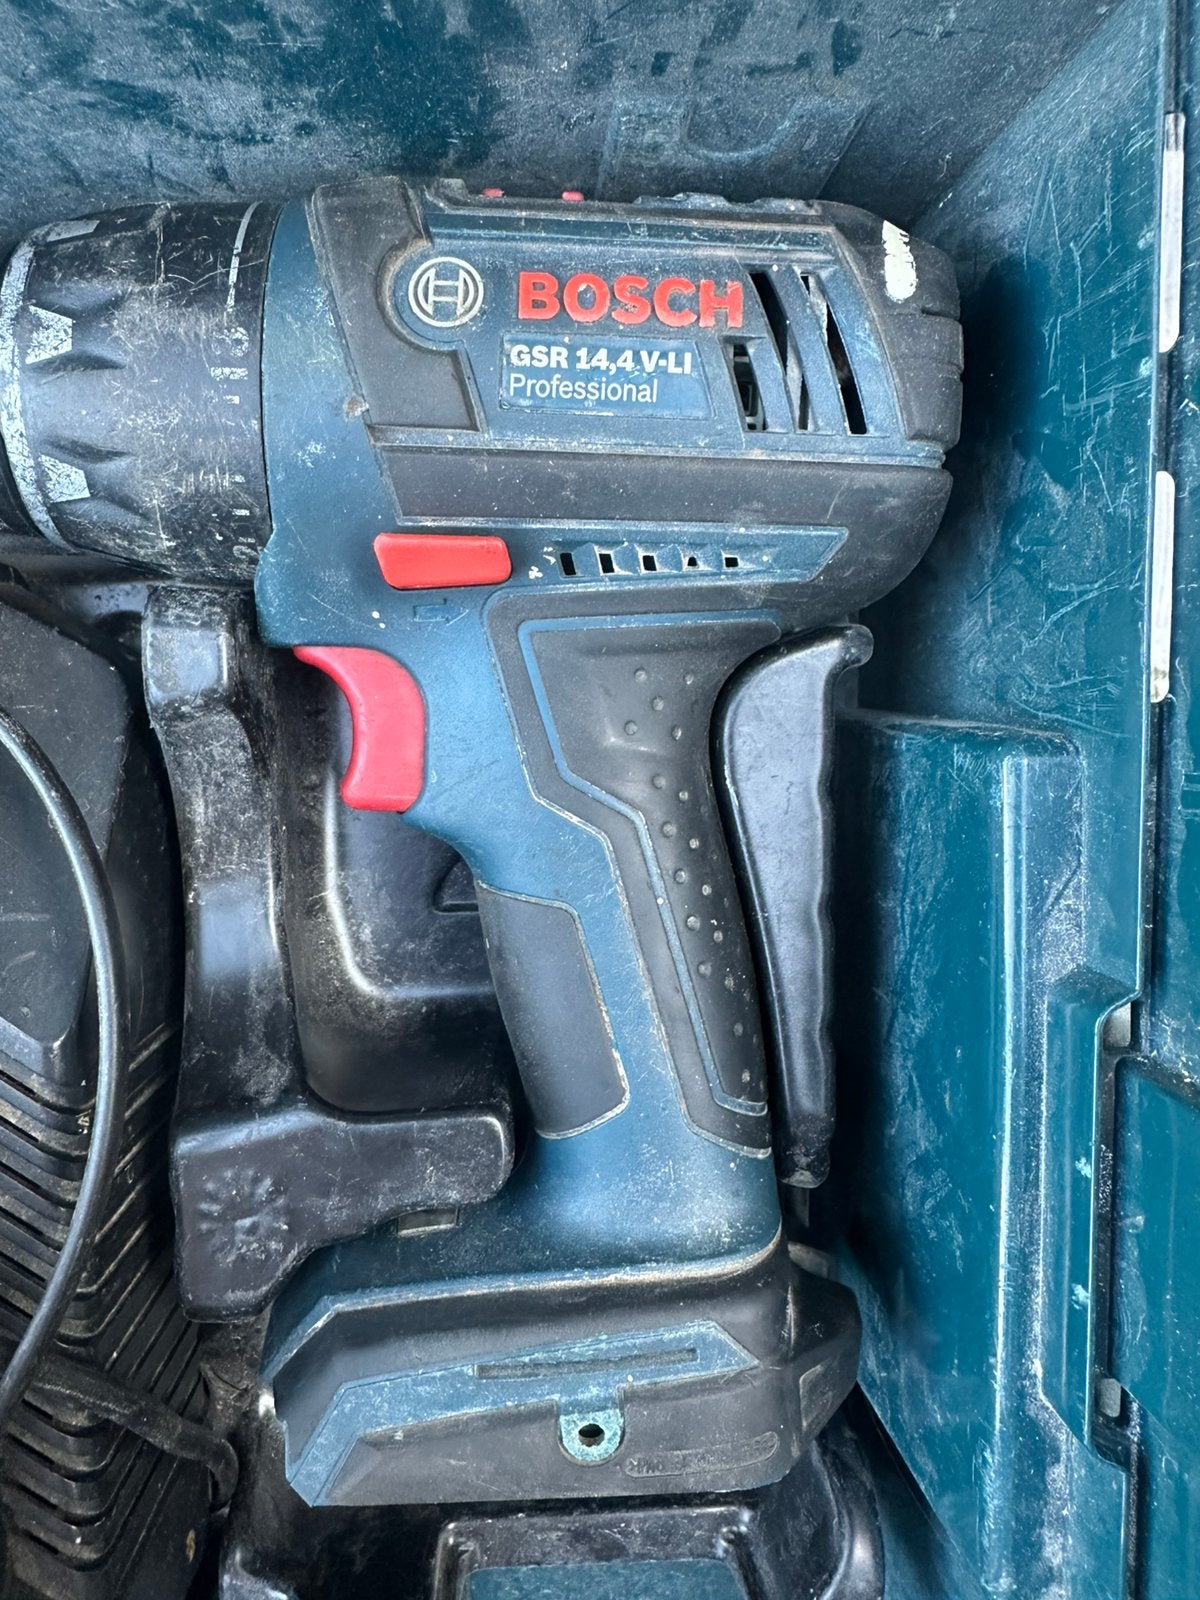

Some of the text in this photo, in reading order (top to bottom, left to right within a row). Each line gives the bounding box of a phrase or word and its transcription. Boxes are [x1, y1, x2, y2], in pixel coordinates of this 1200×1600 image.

[518, 271, 744, 328] BOSCH
[509, 344, 692, 375] GSR 14,4 V-LI
[509, 373, 659, 404] Professional
